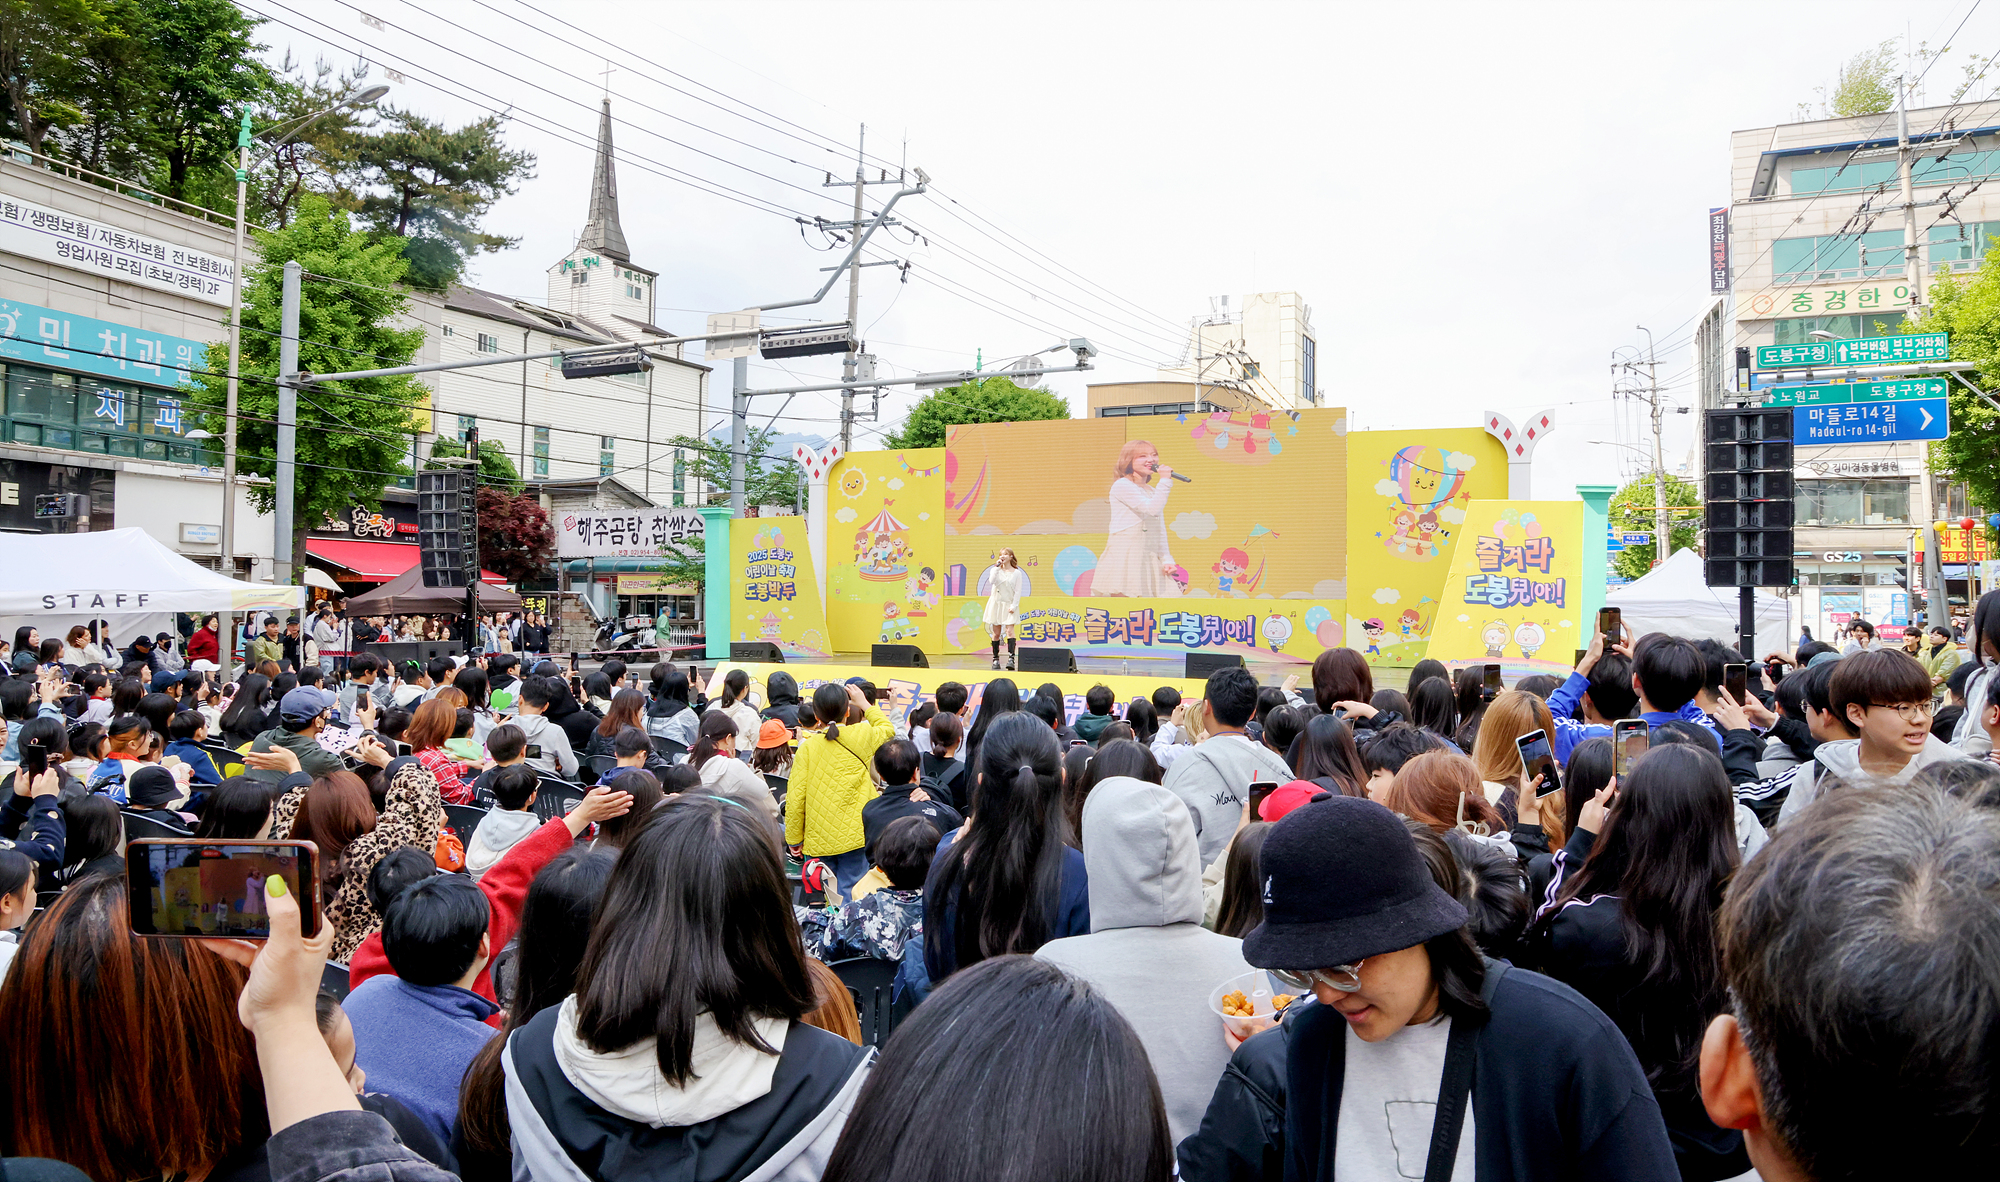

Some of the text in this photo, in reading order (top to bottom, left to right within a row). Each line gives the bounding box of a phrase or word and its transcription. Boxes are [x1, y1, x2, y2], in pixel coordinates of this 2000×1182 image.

[0, 201, 19, 221] 험
[30, 210, 89, 240] 생명보험
[99, 229, 166, 261] 자동차보험
[56, 241, 220, 296] 영업사원 모집 (초보/경력) 2F
[1792, 284, 1940, 313] 중경한의
[39, 316, 71, 360] 민
[96, 329, 166, 377] 치과
[1764, 345, 1825, 362] 도봉구청
[1780, 390, 1820, 403] 노원교
[1870, 382, 1927, 399] 도봉구청
[1809, 404, 1897, 426] 마들로14길
[1809, 423, 1897, 438] Madeul-ro 14-gil
[1832, 461, 1899, 474] 김미경동물병원
[747, 547, 794, 563] 2025 도봉구
[1476, 535, 1555, 574] 즐겨라
[1823, 551, 1862, 563] GS25
[745, 563, 796, 579] 어린이날 축제
[745, 580, 797, 602] 도봉박두
[42, 593, 150, 610] STAFF
[1019, 621, 1077, 642] 도봉박두
[1084, 607, 1157, 646] 즐겨라
